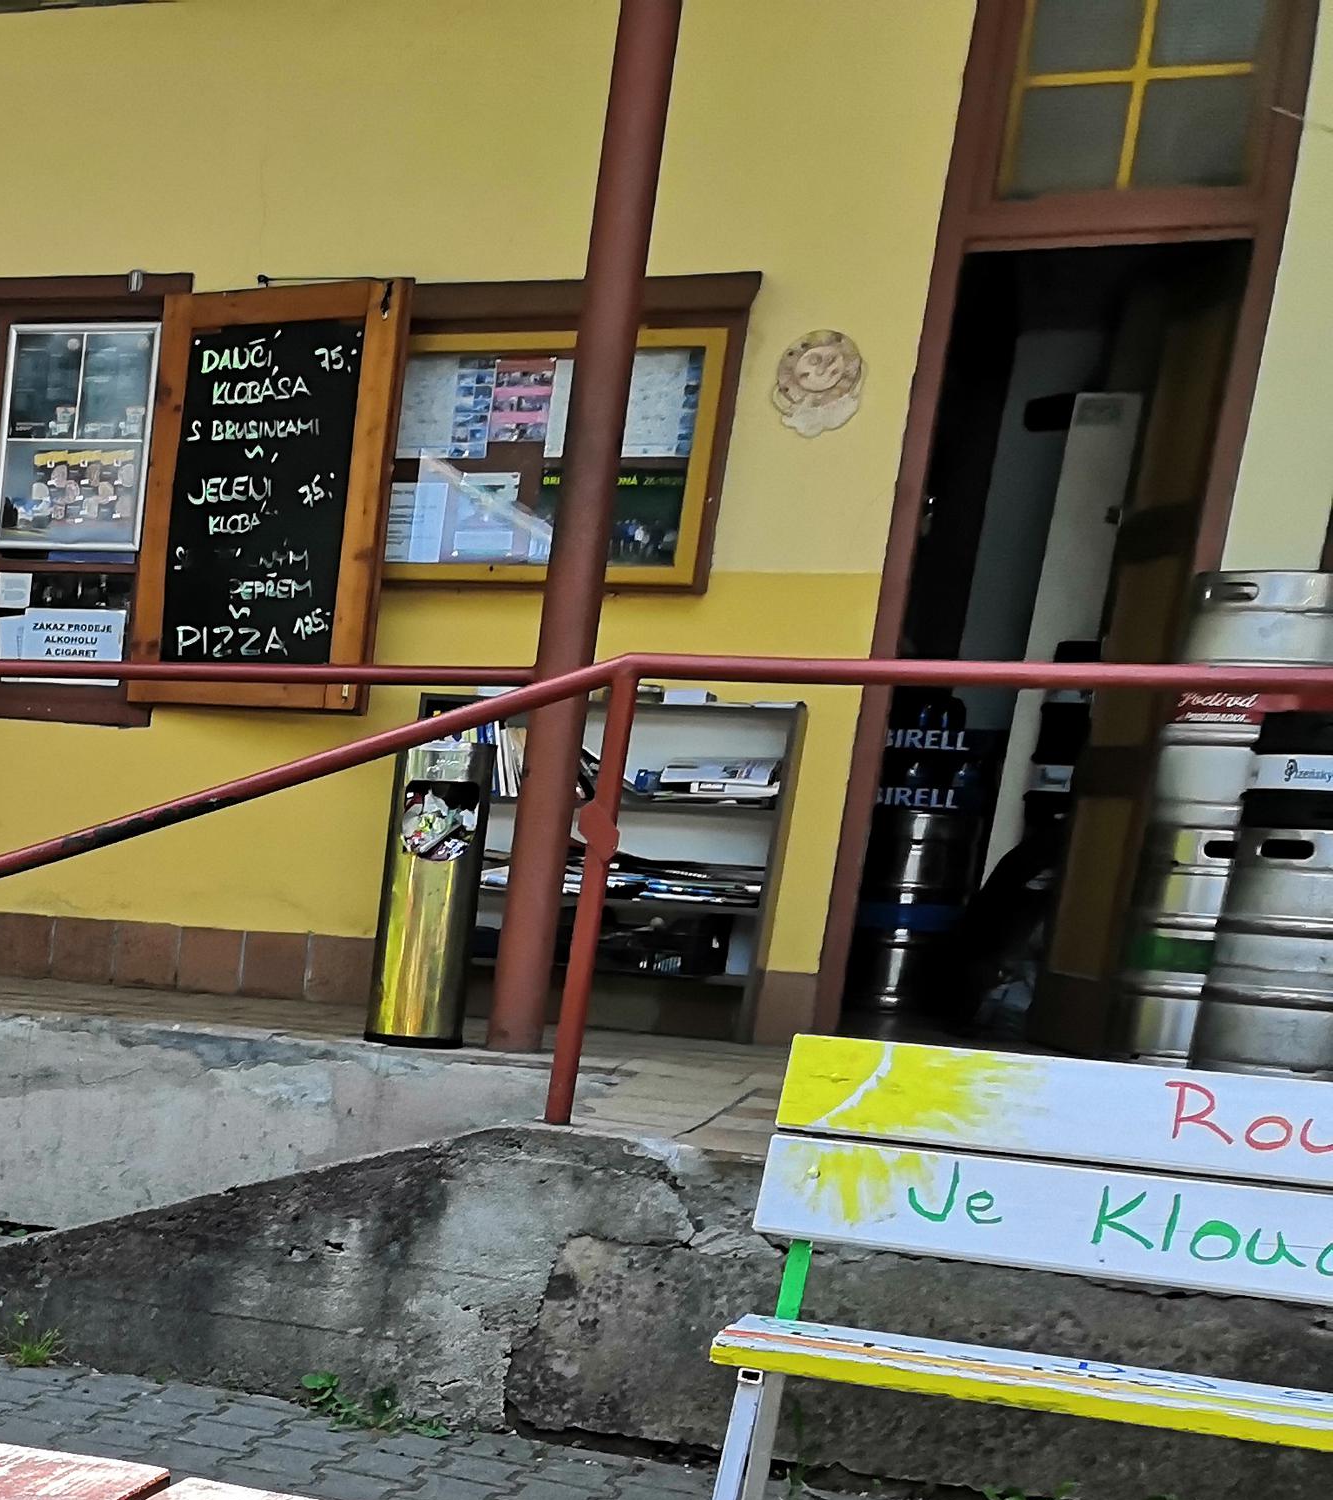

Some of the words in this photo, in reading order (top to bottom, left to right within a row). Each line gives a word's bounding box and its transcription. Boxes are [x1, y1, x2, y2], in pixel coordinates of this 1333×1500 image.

[201, 330, 281, 374] DANČÍ
[212, 366, 312, 405] KLOBÁSA
[186, 420, 202, 441] S
[211, 418, 319, 441] BRUSINKAMI
[187, 453, 278, 505] JELENÍ
[32, 622, 64, 632] ZÁKAZ
[67, 623, 112, 633] PRODEJE
[44, 635, 98, 645] ALKOHOLU
[176, 625, 288, 657] PIZZA
[45, 648, 53, 656] A
[54, 648, 98, 658] CIGARET
[908, 1161, 1002, 1224] Je
